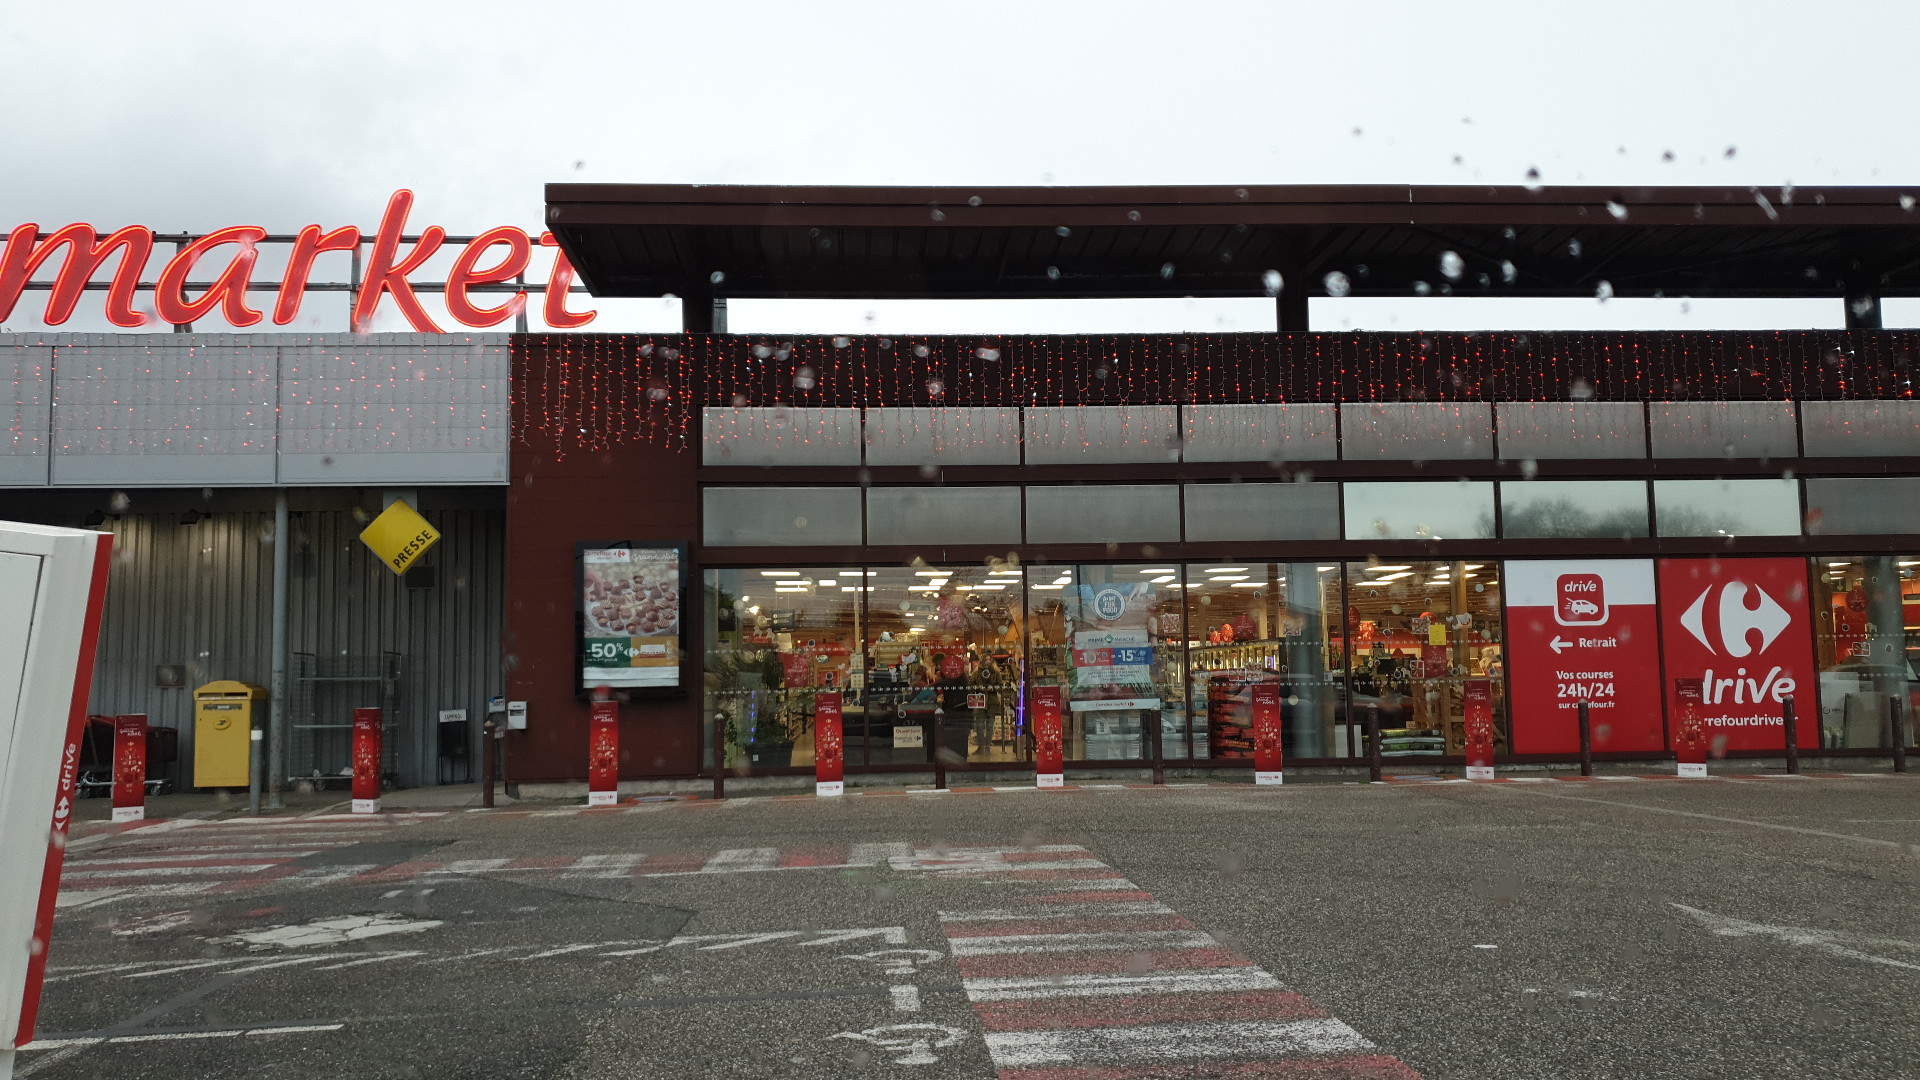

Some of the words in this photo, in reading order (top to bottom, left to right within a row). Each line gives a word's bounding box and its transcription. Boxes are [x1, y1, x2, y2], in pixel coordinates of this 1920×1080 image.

[0, 188, 597, 333] market
[393, 530, 433, 568] PRESSE
[1564, 580, 1597, 592] drive
[1579, 637, 1617, 647] Retrait
[1556, 671, 1575, 679] Vos
[1576, 671, 1614, 679] courses
[1557, 682, 1615, 698] 24h/24
[1571, 700, 1616, 709] caefour.fr
[1704, 715, 1798, 726] refourdrive
[62, 743, 76, 791] drive
